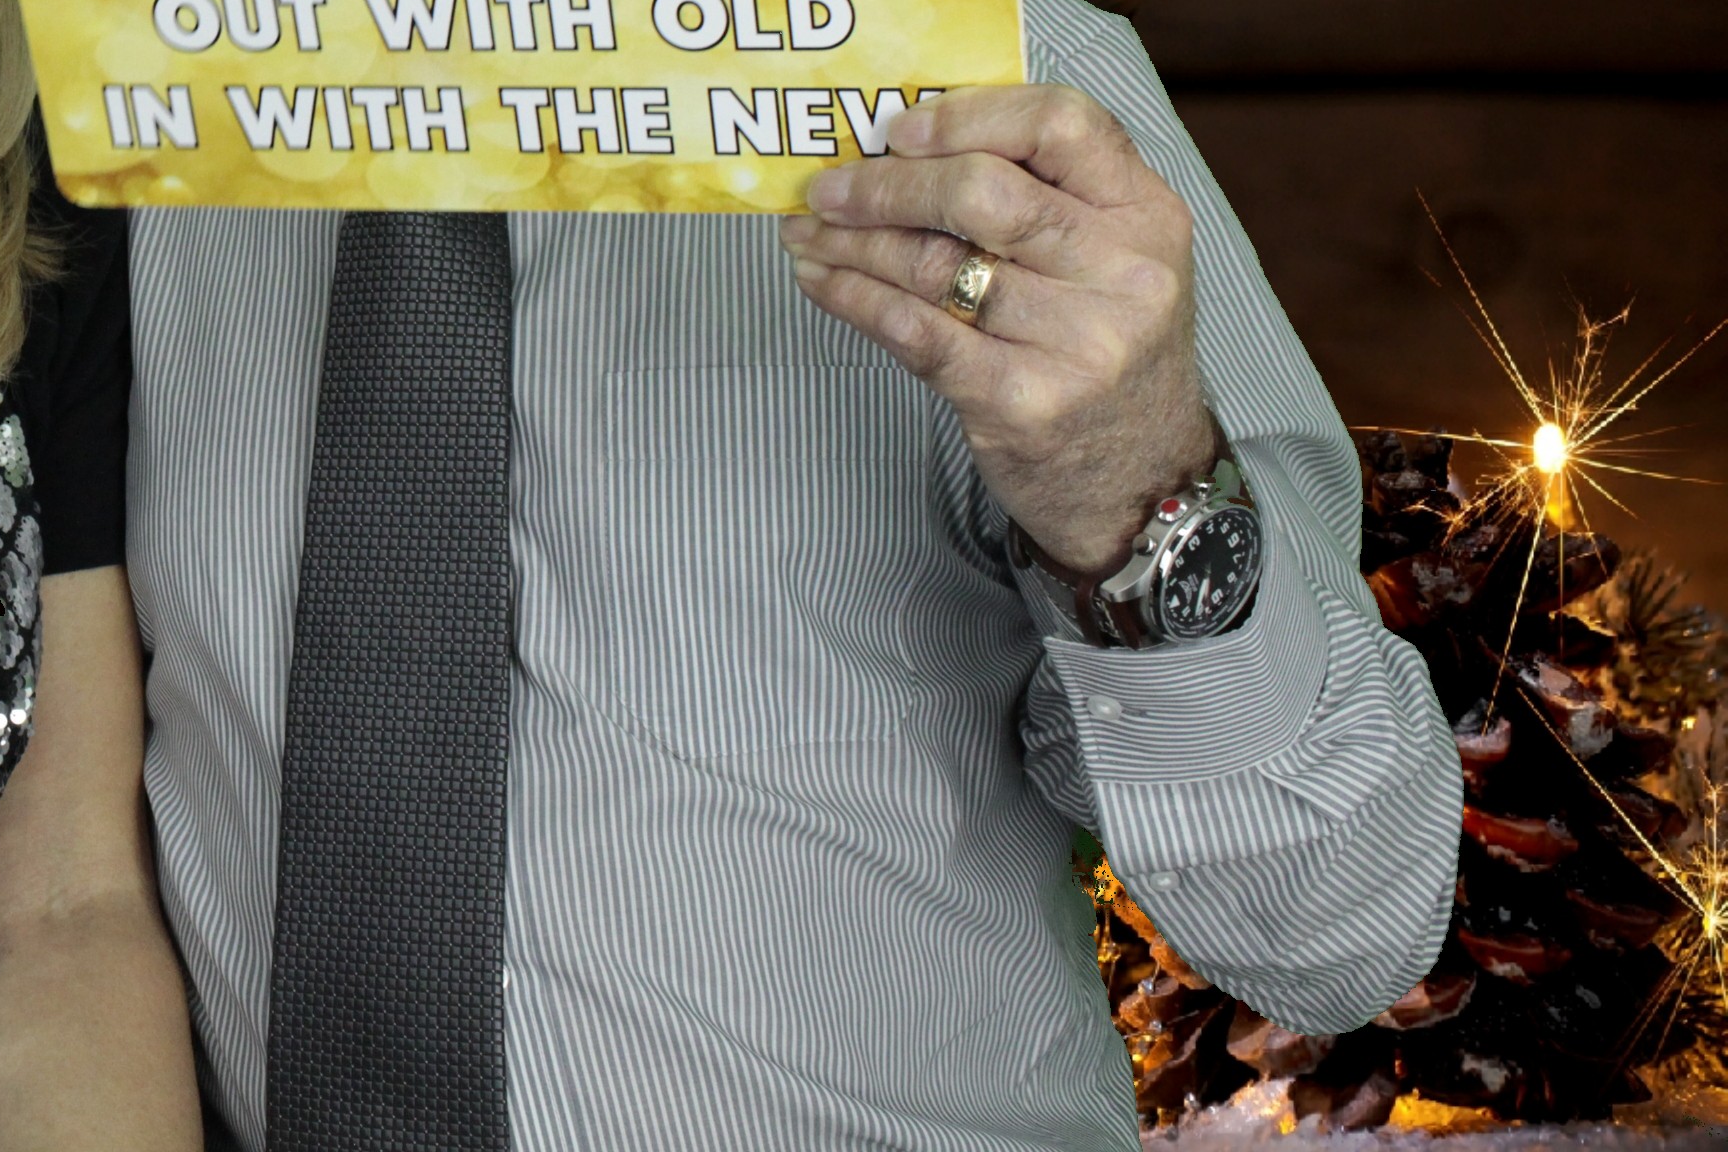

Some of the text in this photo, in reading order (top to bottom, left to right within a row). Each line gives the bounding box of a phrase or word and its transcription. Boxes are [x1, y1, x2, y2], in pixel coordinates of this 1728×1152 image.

[102, 83, 199, 150] IN
[223, 85, 470, 152] WITH
[498, 86, 675, 155] THE
